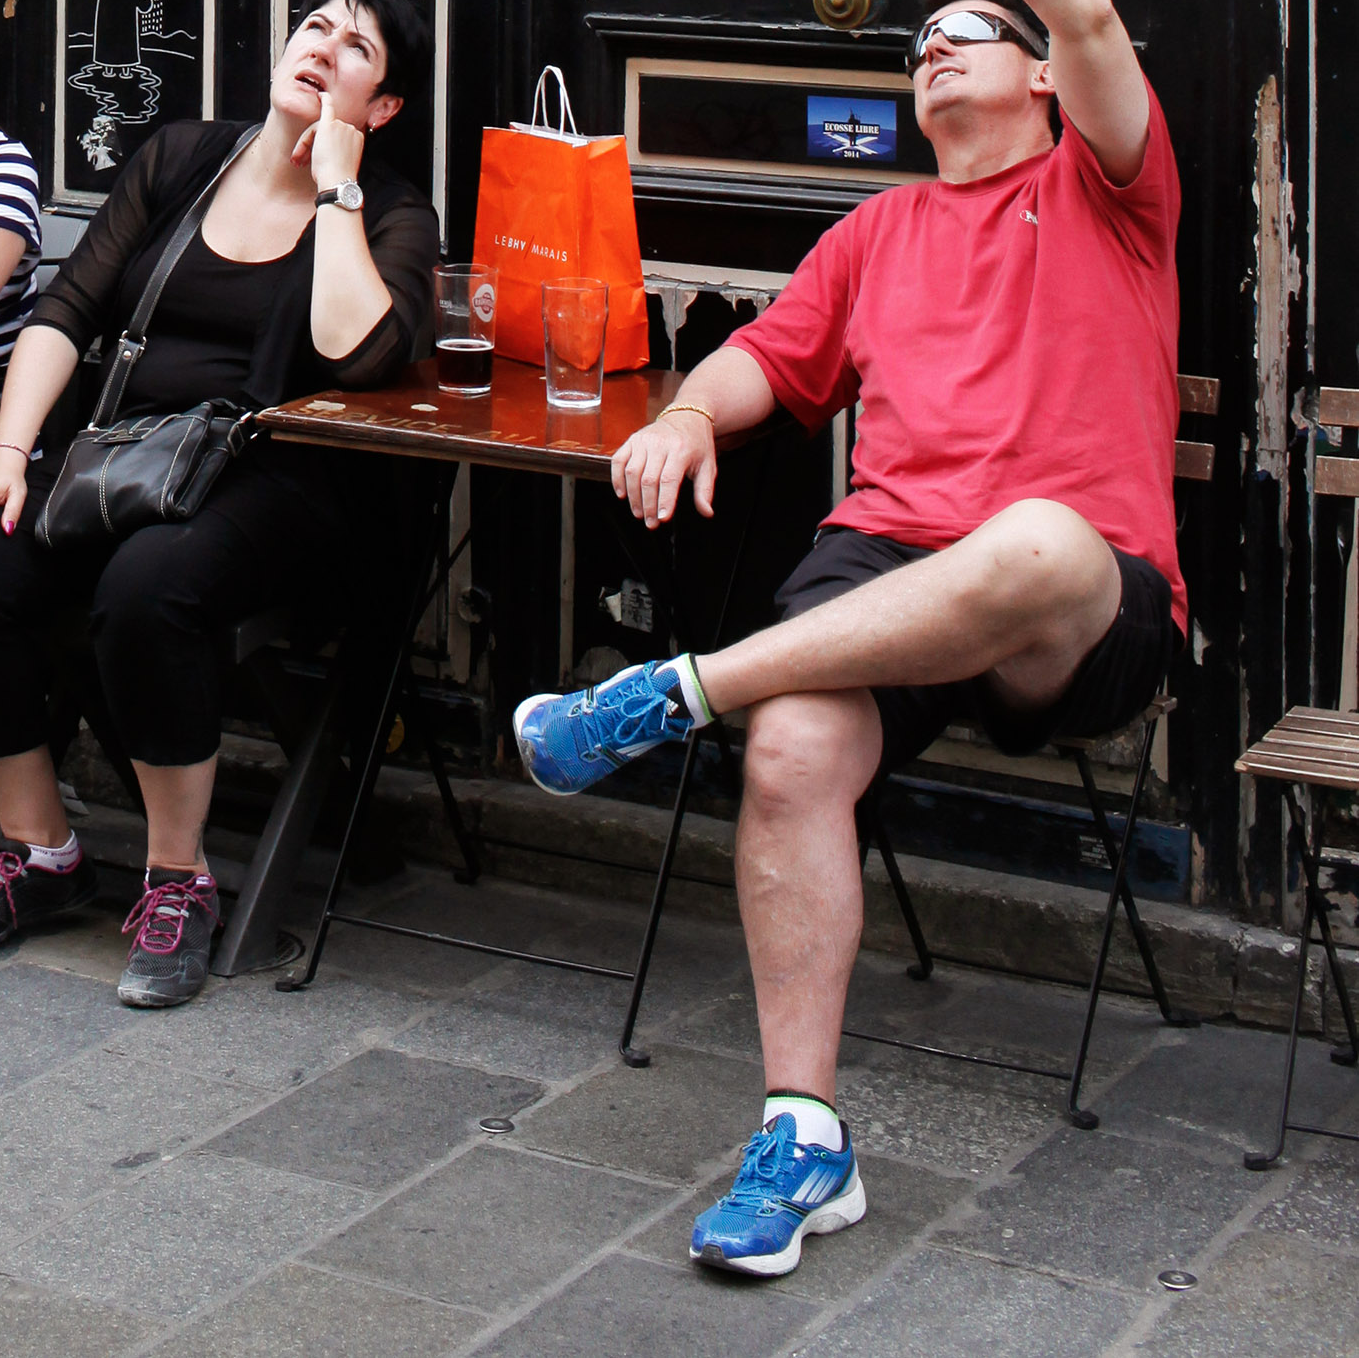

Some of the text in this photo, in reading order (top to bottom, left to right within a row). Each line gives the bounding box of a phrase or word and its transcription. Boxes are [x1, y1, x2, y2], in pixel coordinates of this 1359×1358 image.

[824, 123, 880, 135] ECOSSE LIBRE
[843, 150, 860, 159] 2014
[531, 243, 568, 262] MARAIS
